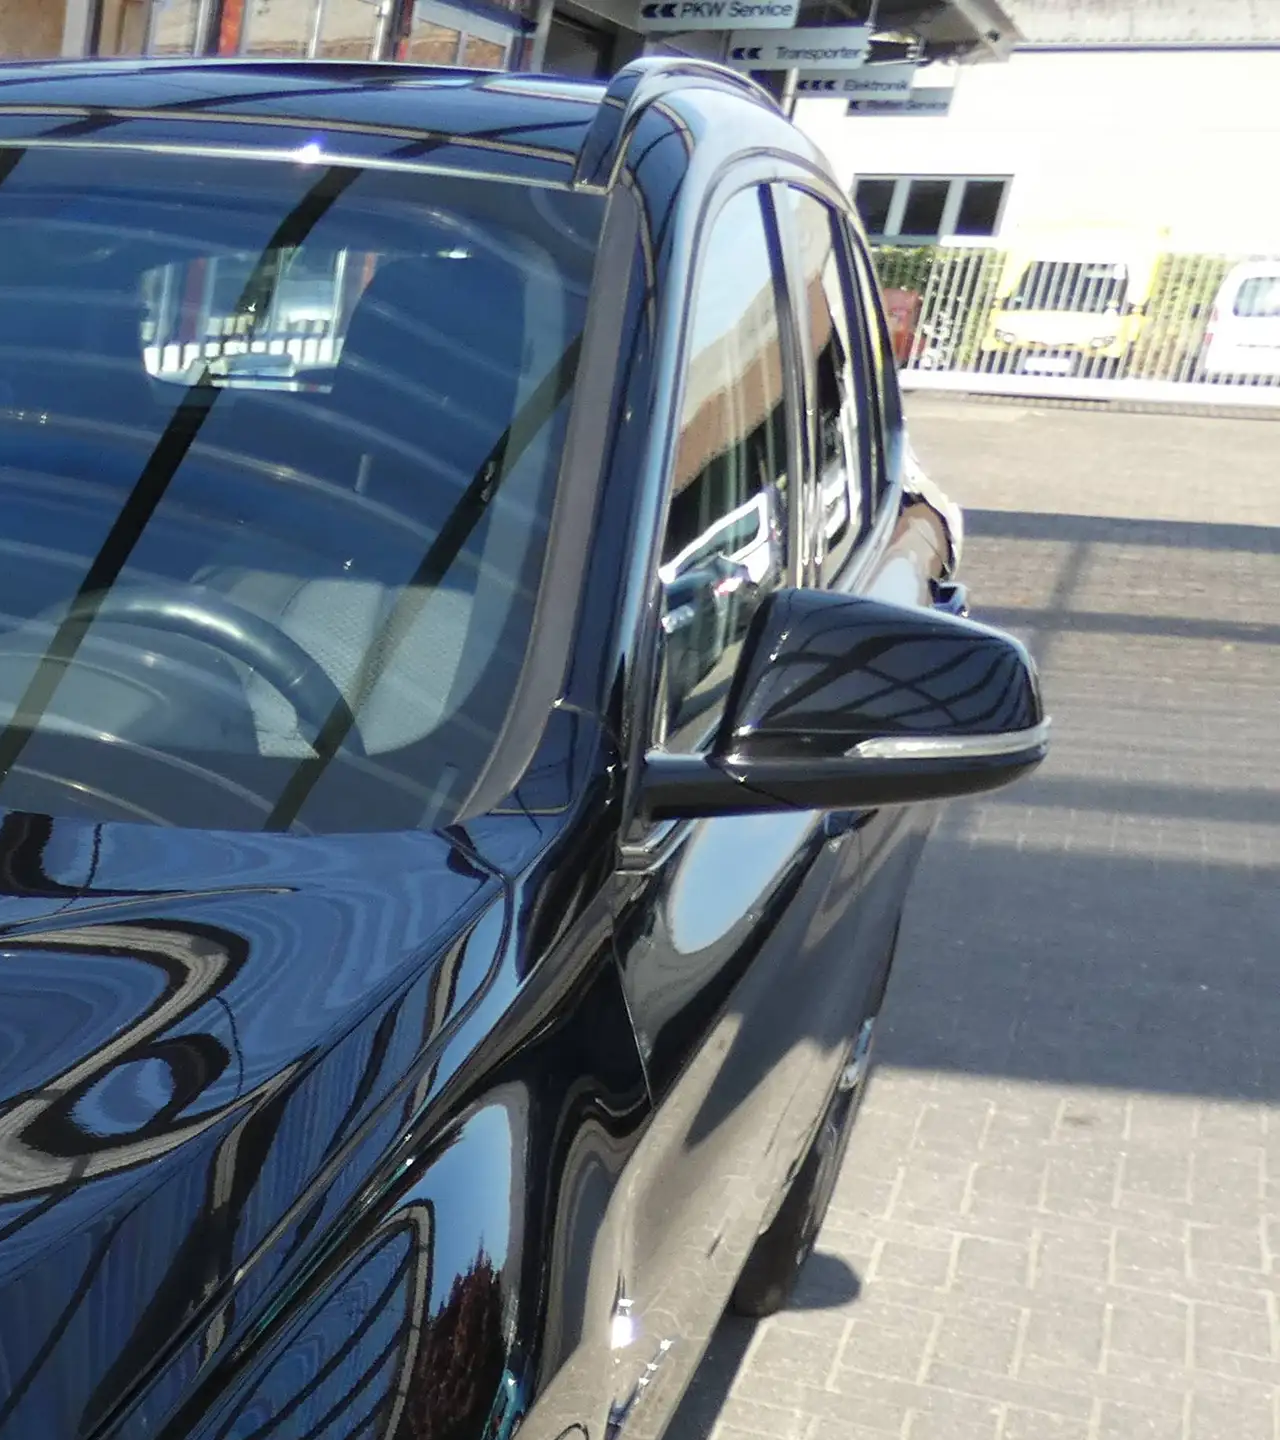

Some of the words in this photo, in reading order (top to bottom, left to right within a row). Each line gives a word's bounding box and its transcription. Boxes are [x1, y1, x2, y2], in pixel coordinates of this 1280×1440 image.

[680, 2, 726, 19] PKW
[728, 1, 793, 17] Service
[776, 46, 862, 63] Transporter
[843, 78, 910, 92] Elektronik
